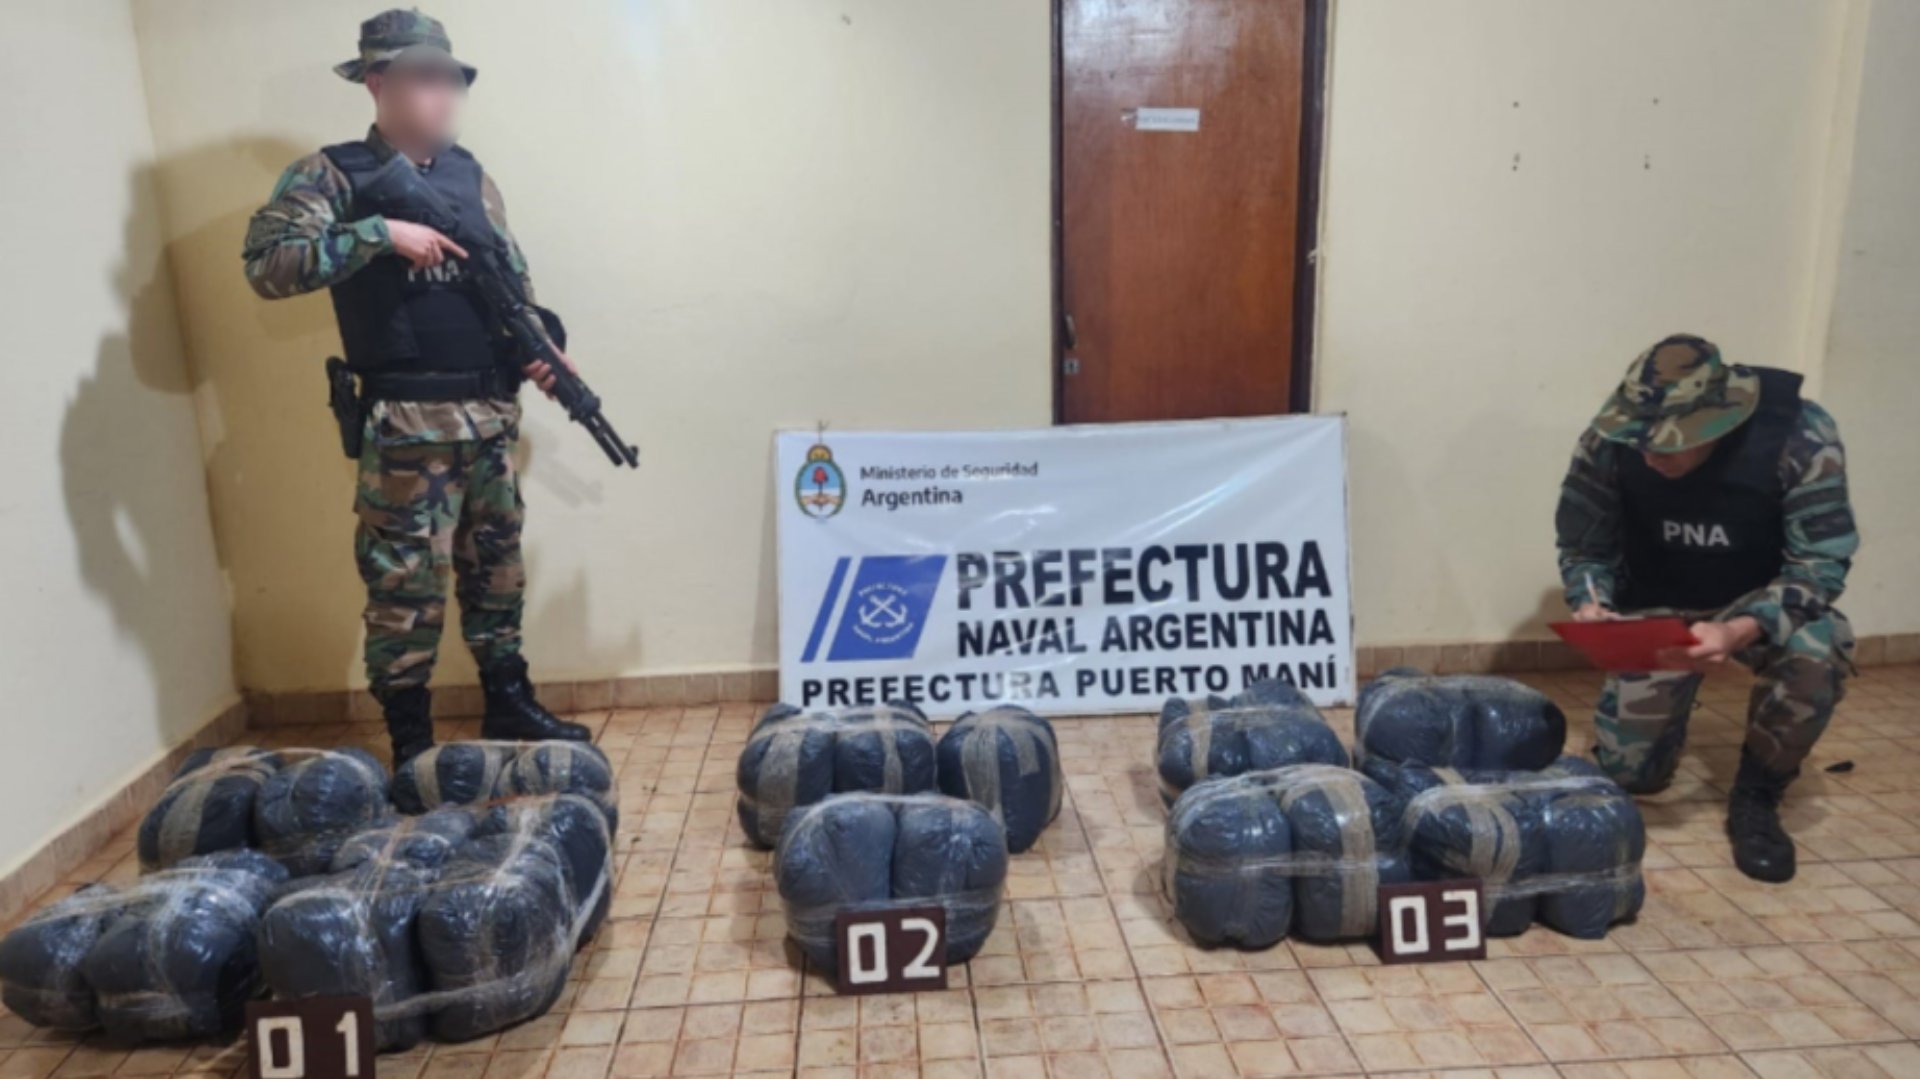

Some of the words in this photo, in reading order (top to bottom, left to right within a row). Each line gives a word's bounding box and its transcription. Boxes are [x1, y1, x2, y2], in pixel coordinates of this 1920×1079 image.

[860, 465, 936, 480] Ministerio
[941, 464, 959, 478] de
[962, 462, 1039, 481] Seguridad
[862, 486, 963, 511] Argentina
[1663, 520, 1730, 546] PNA
[957, 540, 1333, 610] PREFECTURA
[957, 617, 1087, 657] NAVAL
[1101, 609, 1335, 653] ARGENTINA
[802, 670, 1061, 707] PREFECTURA
[1076, 665, 1229, 697] PUERTO
[1389, 889, 1480, 954] 03
[847, 918, 940, 984] 02
[257, 1010, 360, 1079] 01
